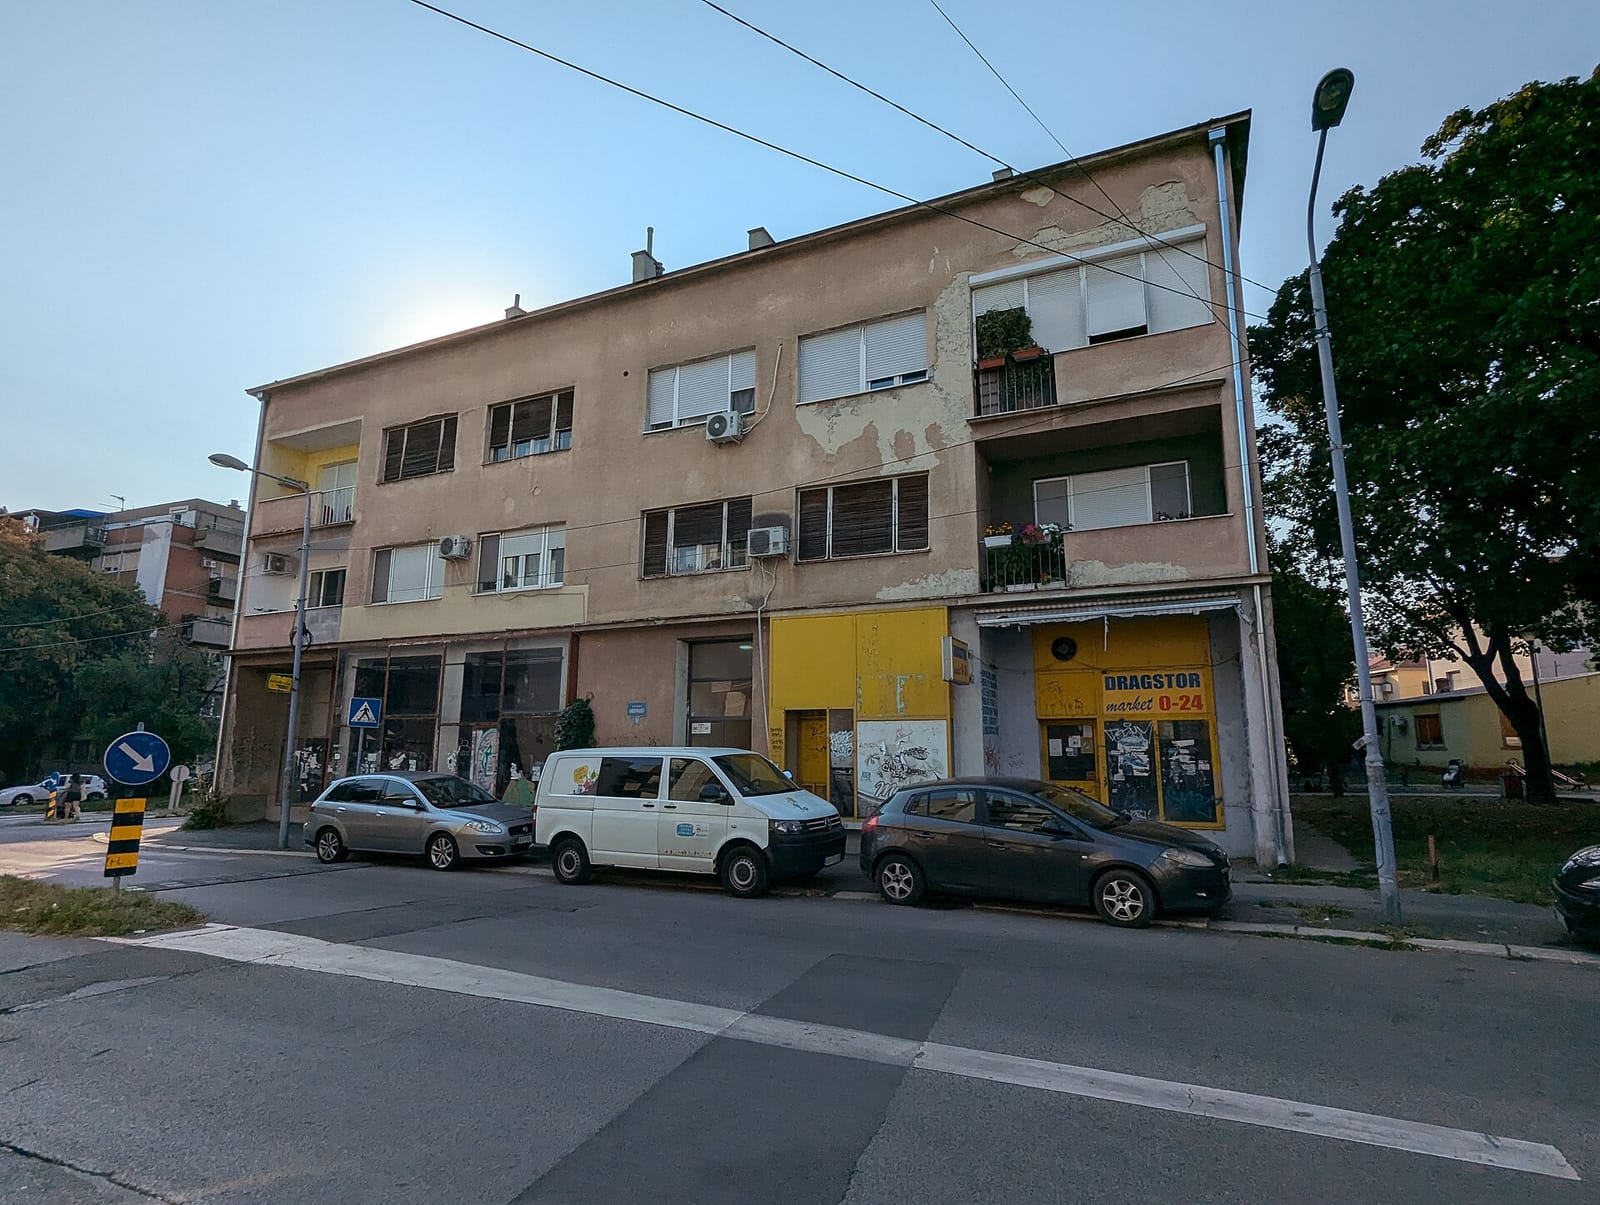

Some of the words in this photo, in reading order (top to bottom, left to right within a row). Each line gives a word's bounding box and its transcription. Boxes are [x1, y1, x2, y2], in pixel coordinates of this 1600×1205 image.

[1105, 673, 1201, 690] DRAGSTOR
[1106, 695, 1153, 711] market
[1159, 695, 1203, 711] 0-24
